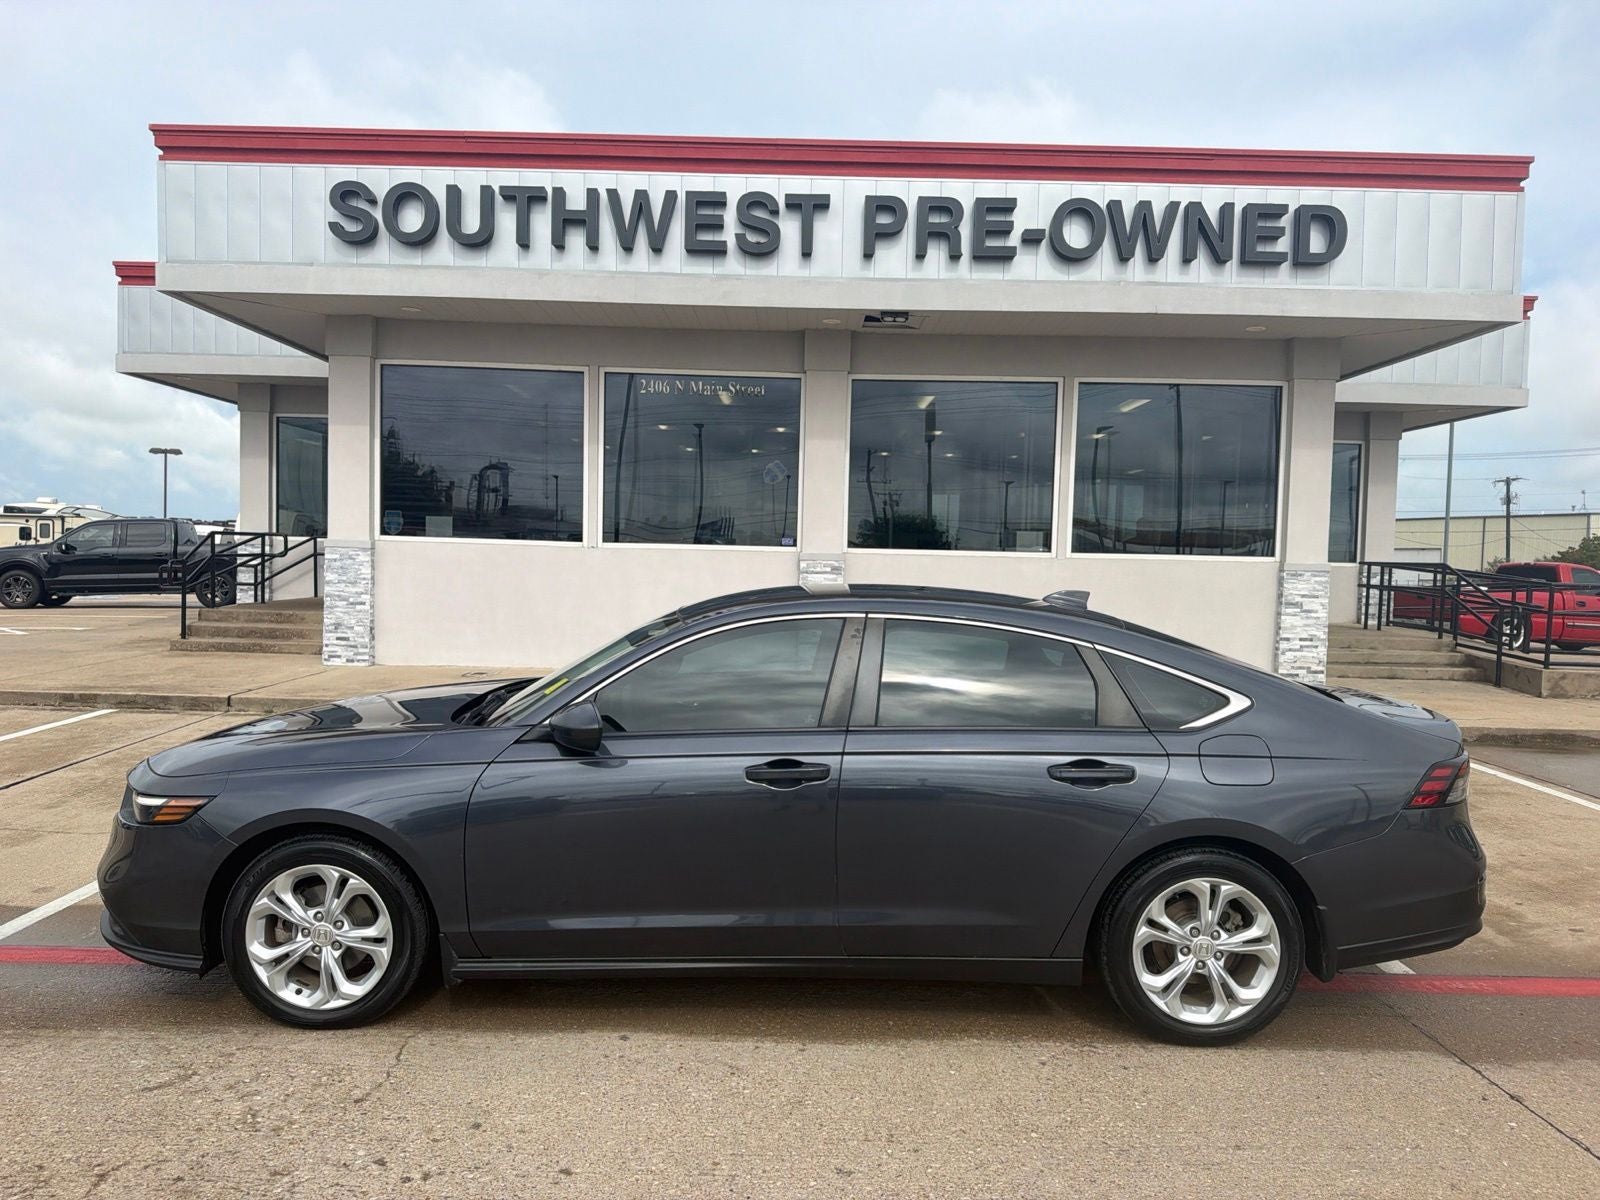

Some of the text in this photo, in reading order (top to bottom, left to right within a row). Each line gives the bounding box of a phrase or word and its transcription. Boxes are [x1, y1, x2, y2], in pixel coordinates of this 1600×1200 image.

[328, 180, 1348, 266] SOUTHWEST PRE-OWNED
[639, 379, 766, 397] 2406 N Main Street
